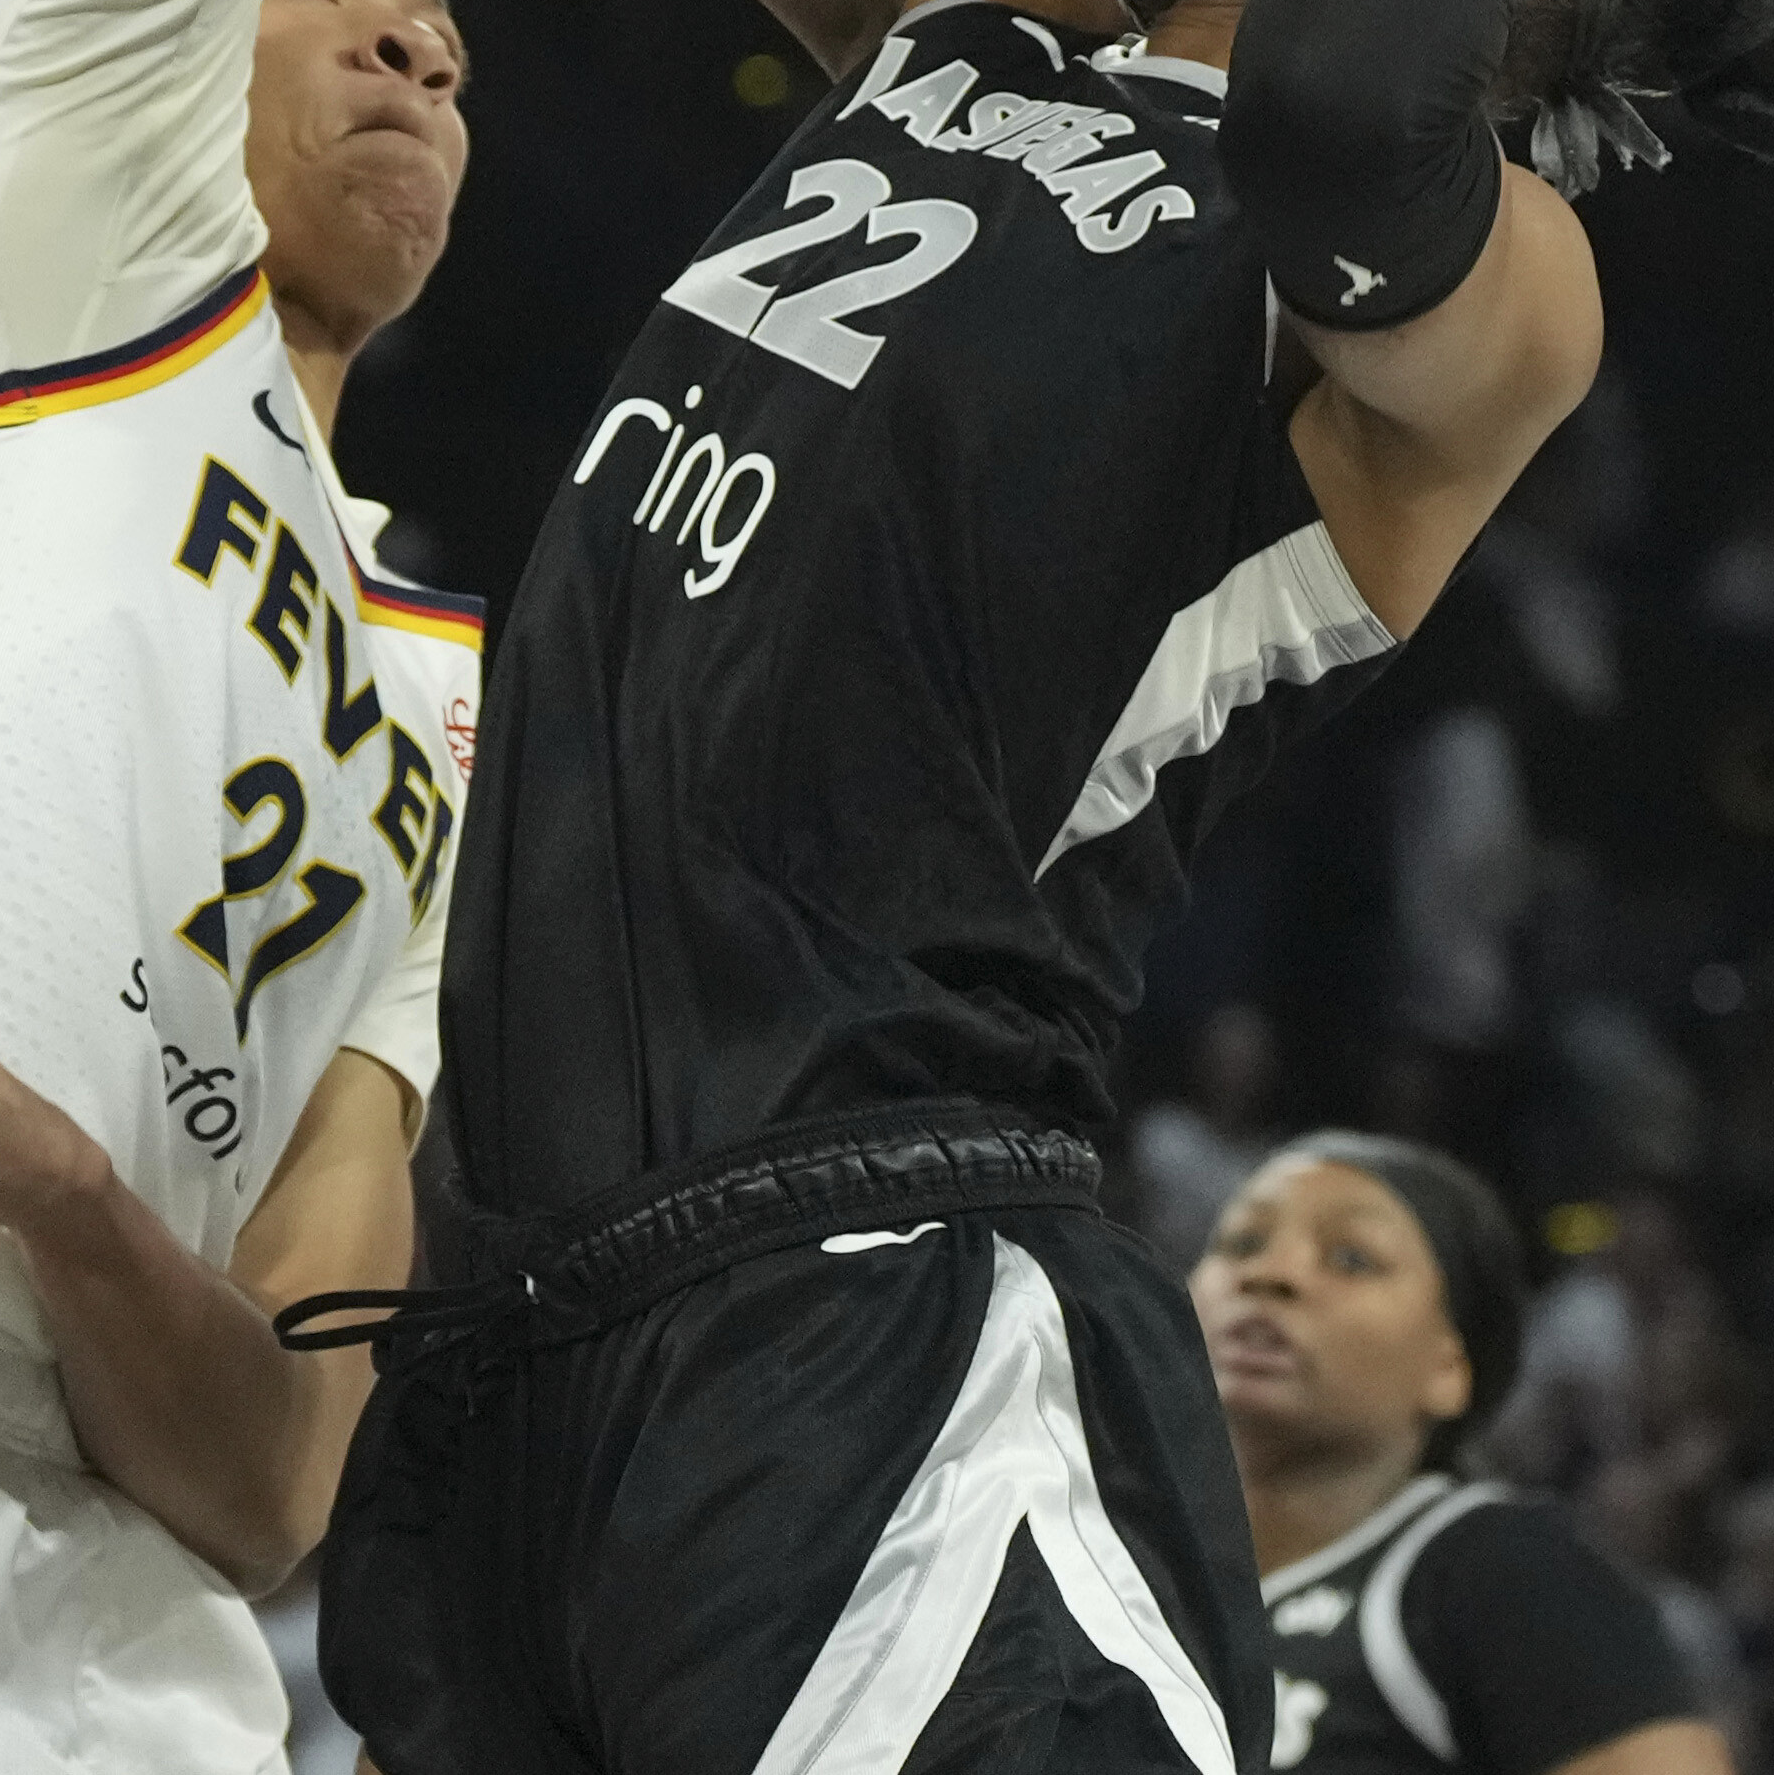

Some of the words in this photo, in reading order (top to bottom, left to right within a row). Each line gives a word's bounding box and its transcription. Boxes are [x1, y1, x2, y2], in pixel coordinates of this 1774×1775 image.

[661, 158, 979, 390] 22
[572, 384, 777, 600] ring
[174, 754, 368, 1048] 21
